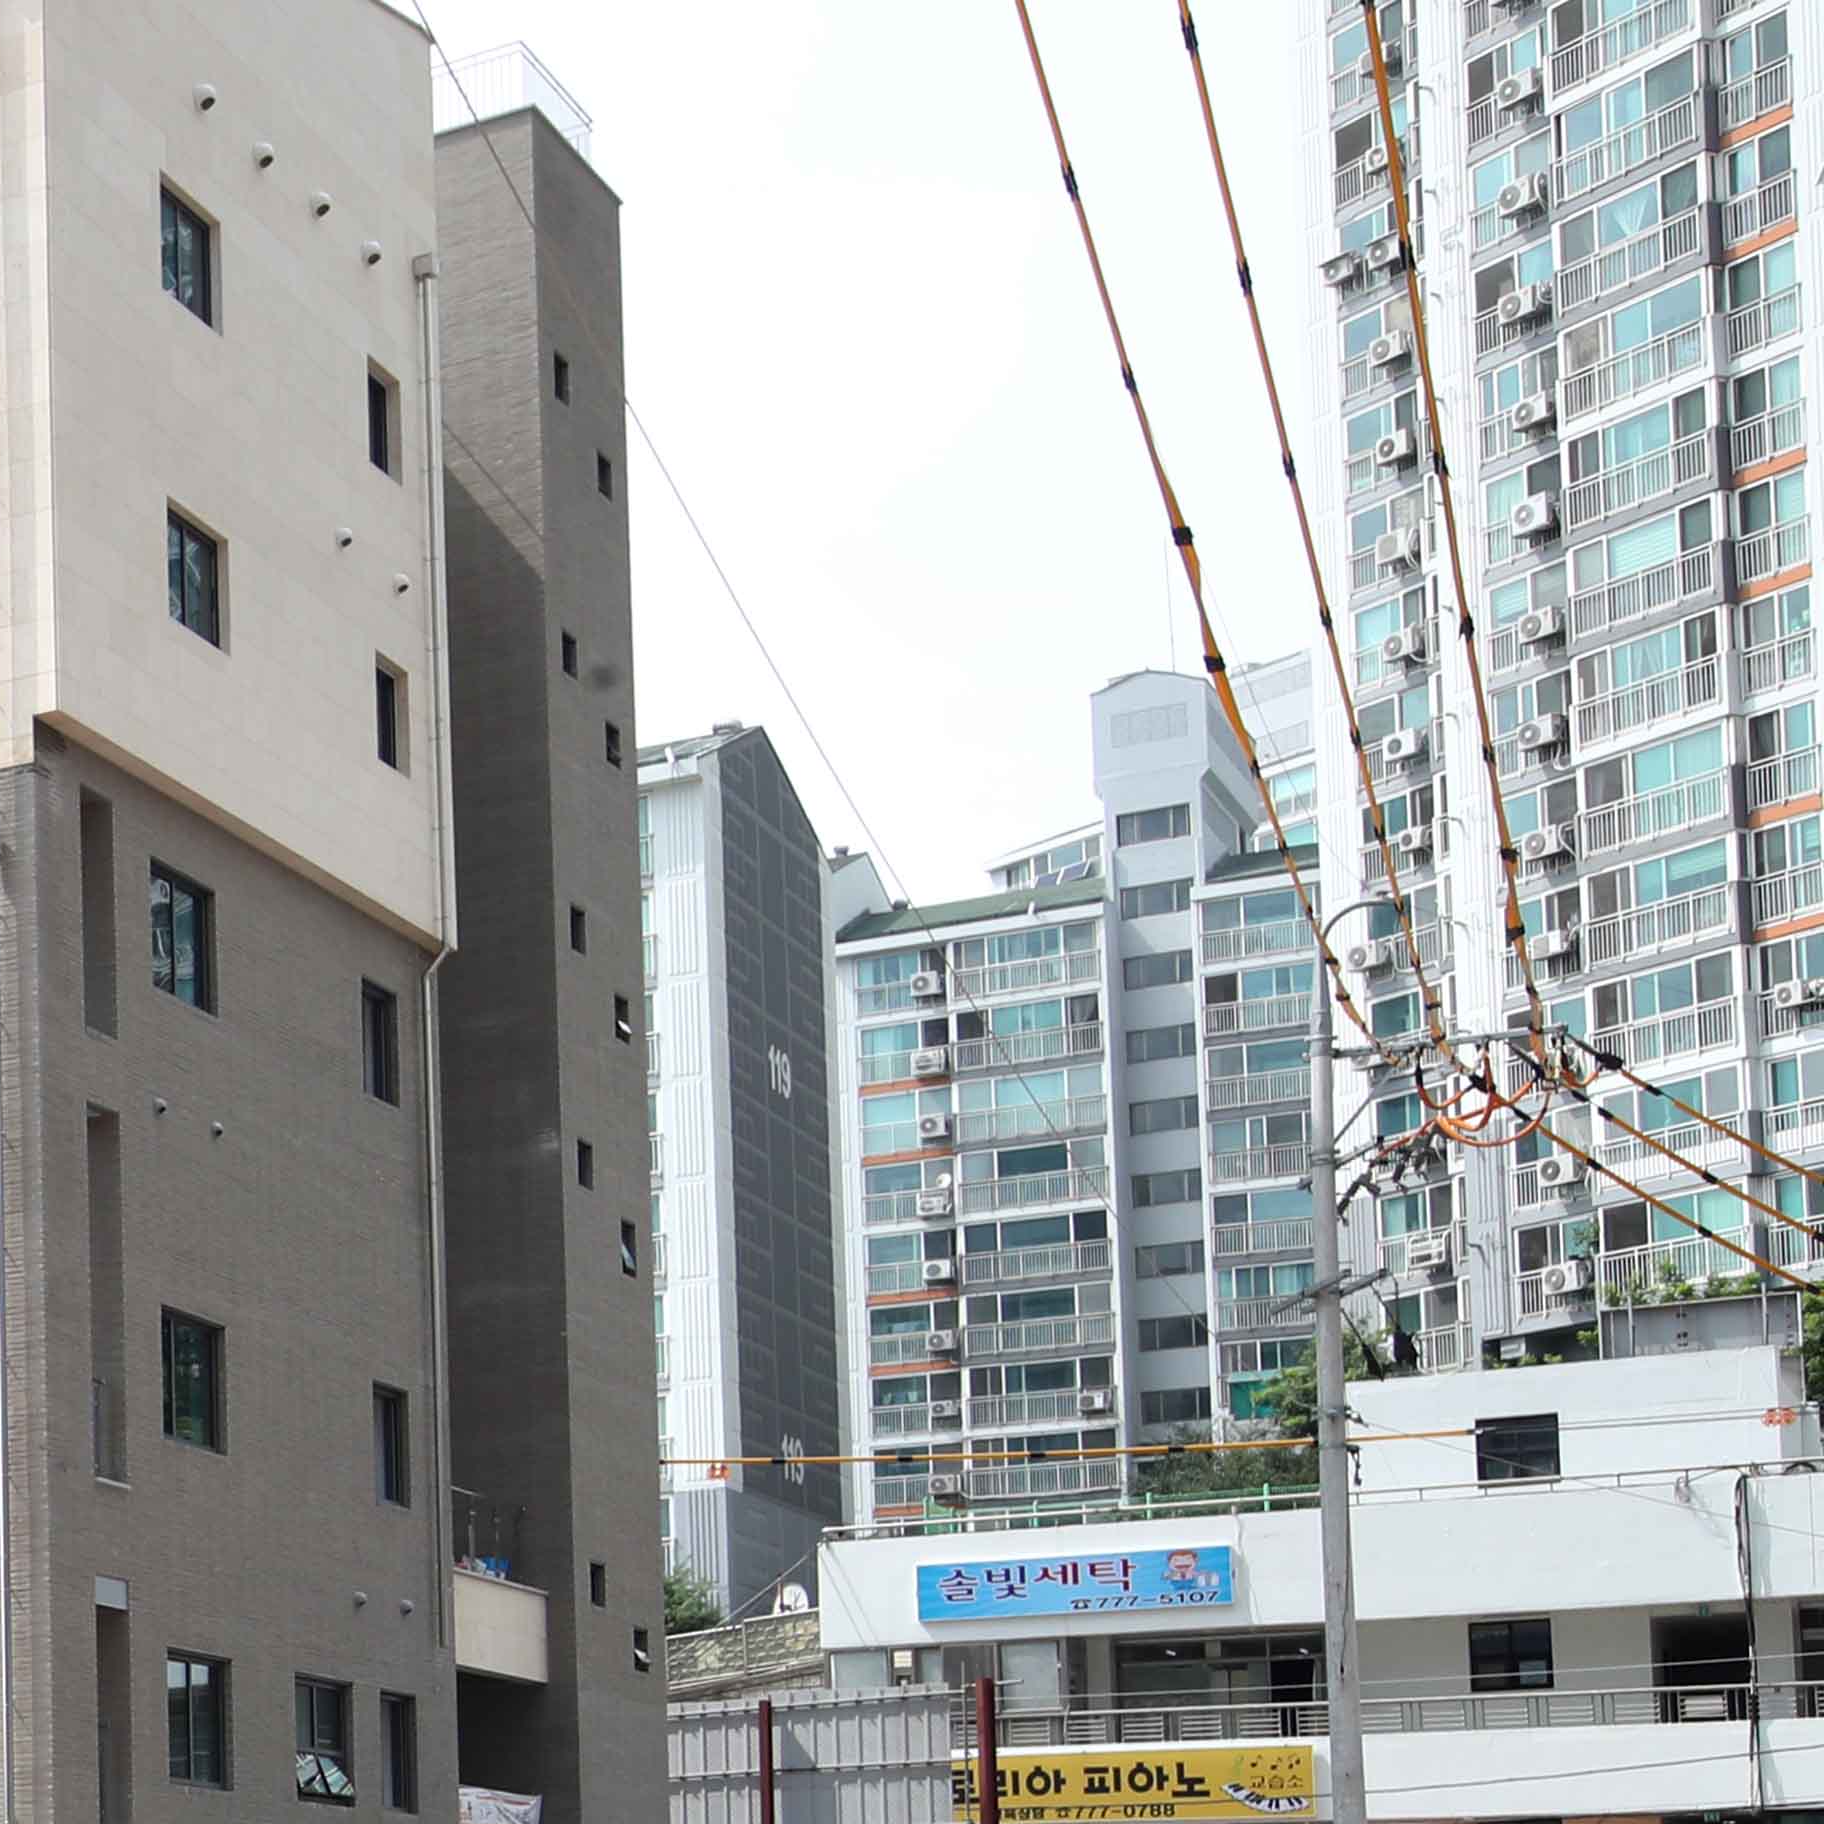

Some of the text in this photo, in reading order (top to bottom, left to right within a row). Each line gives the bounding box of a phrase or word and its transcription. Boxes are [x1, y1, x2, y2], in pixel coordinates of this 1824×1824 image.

[768, 1044, 792, 1099] 119
[939, 1558, 1137, 1602] 솔빛세탁
[1098, 1590, 1219, 1608] 777-5107
[1083, 1761, 1211, 1799] 피아노
[1002, 1803, 1176, 1820] 육상담 777-0788
